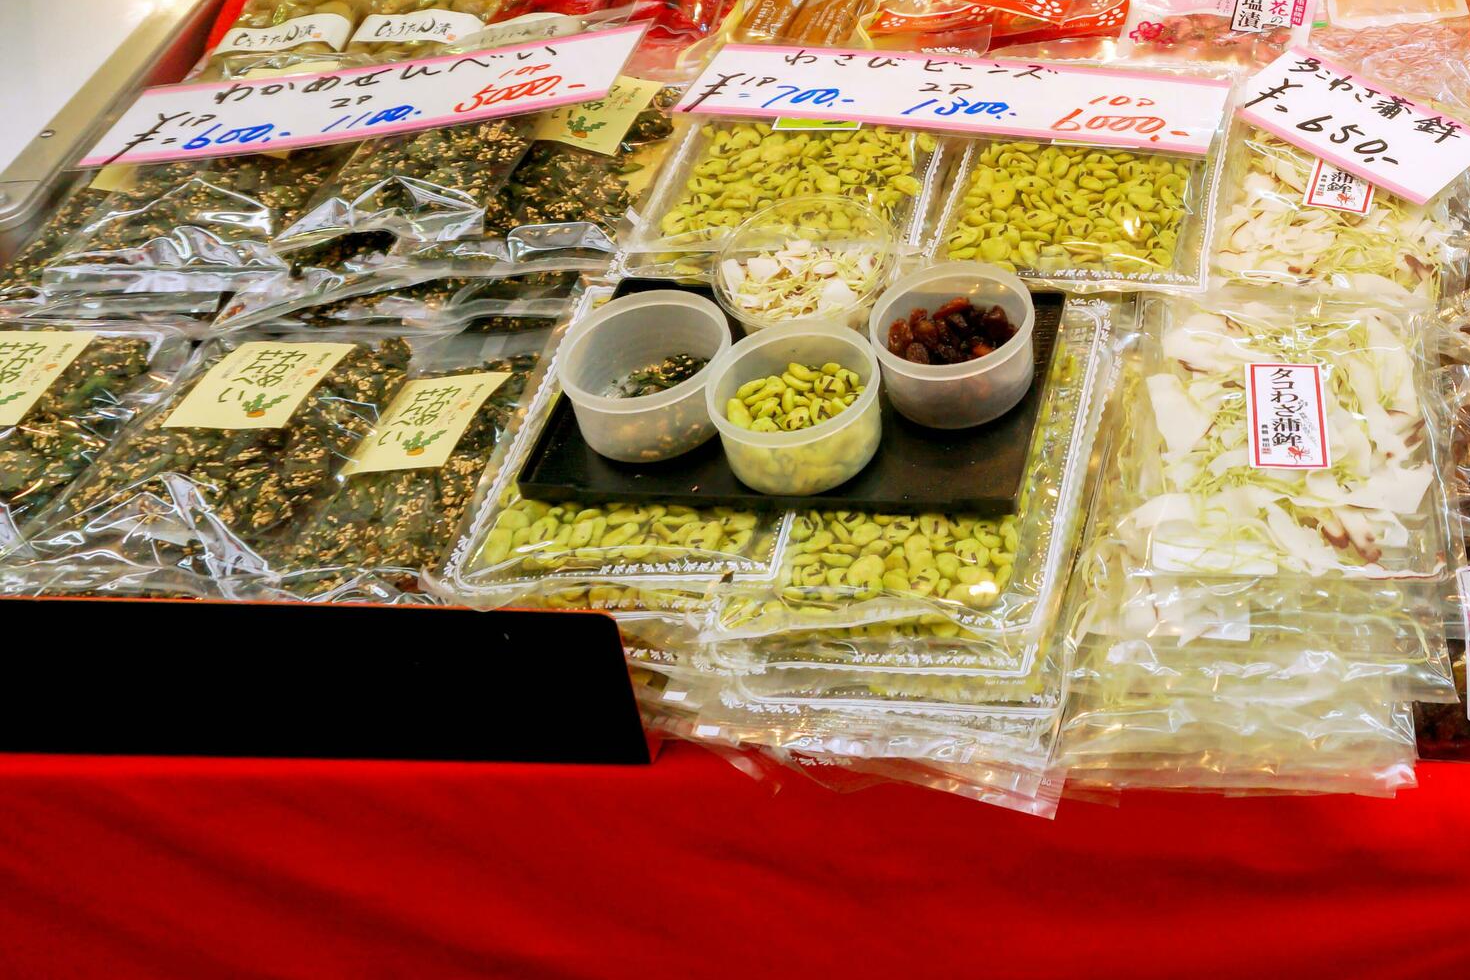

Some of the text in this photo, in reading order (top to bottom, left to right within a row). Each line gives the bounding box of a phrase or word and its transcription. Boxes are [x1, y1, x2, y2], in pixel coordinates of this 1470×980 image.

[232, 22, 318, 49] ひょうたん漬
[374, 19, 454, 44] ひょうたん漬
[213, 44, 560, 105] わかめせんべい
[330, 95, 374, 110] 2P
[498, 63, 552, 80] 10P
[917, 81, 974, 95] 2P
[1269, 368, 1303, 448] タコわさ蒲鉾
